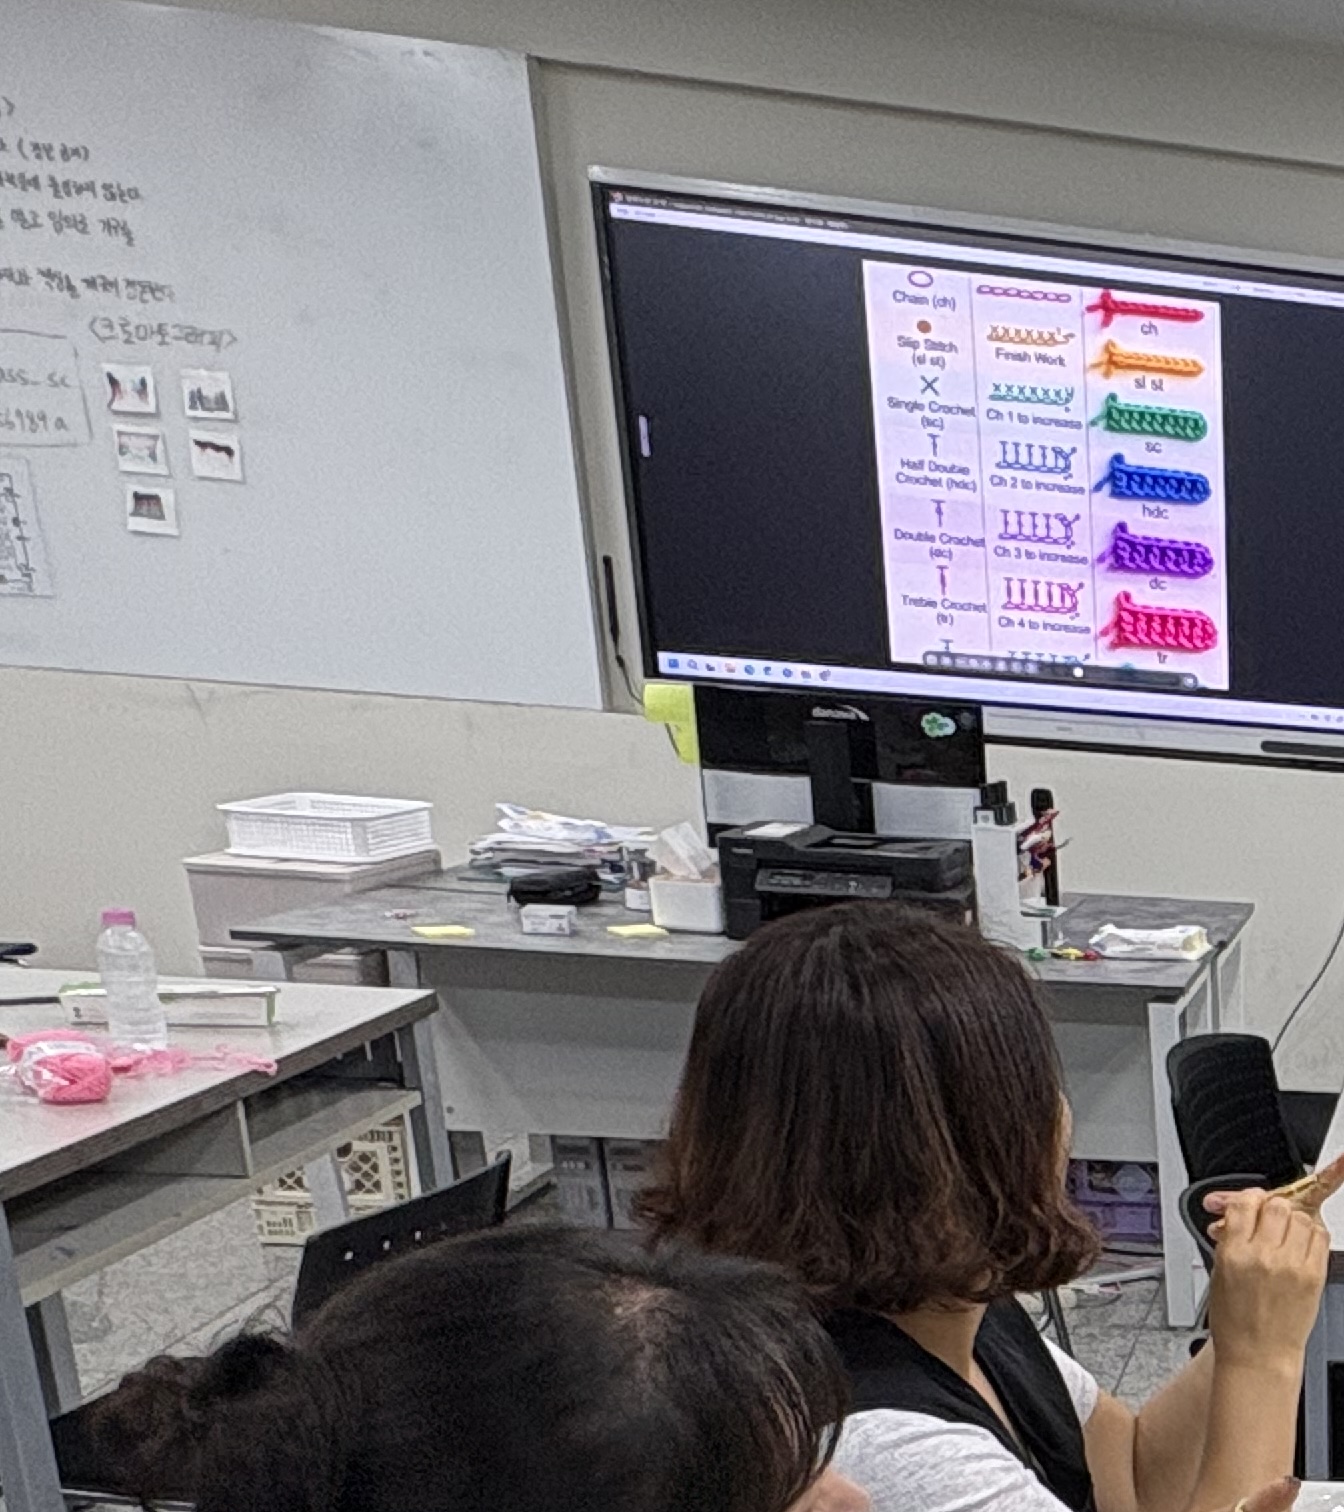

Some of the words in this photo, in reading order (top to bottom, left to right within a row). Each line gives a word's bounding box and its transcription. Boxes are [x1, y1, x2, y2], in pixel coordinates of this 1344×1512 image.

[893, 290, 929, 305] Chain
[1140, 321, 1159, 335] ch
[995, 347, 1031, 363] Finish
[1034, 350, 1066, 367] Work
[887, 396, 925, 413] Single
[928, 401, 976, 418] Crochet
[986, 408, 1004, 422] Ch
[1016, 412, 1030, 424] to
[1032, 413, 1083, 430] increase
[901, 458, 925, 472] Half
[929, 460, 970, 475] Double
[895, 472, 943, 488] Crochet
[946, 475, 978, 493] (hdc)
[989, 474, 1008, 488] Ch
[1010, 476, 1018, 488] 2
[1020, 478, 1034, 490] to
[1035, 479, 1086, 495] increase
[1141, 504, 1170, 520] hdc
[894, 528, 936, 544] Double
[939, 532, 986, 548] Crochet
[994, 545, 1011, 559] Ch
[1014, 547, 1022, 559] 3
[1024, 549, 1038, 560] to
[1038, 549, 1088, 566] increase
[1149, 577, 1168, 591] dc
[941, 598, 988, 614] Crochet
[998, 616, 1016, 629] Ch
[1018, 617, 1026, 629] 4
[1028, 619, 1040, 630] to
[1042, 620, 1091, 635] increase
